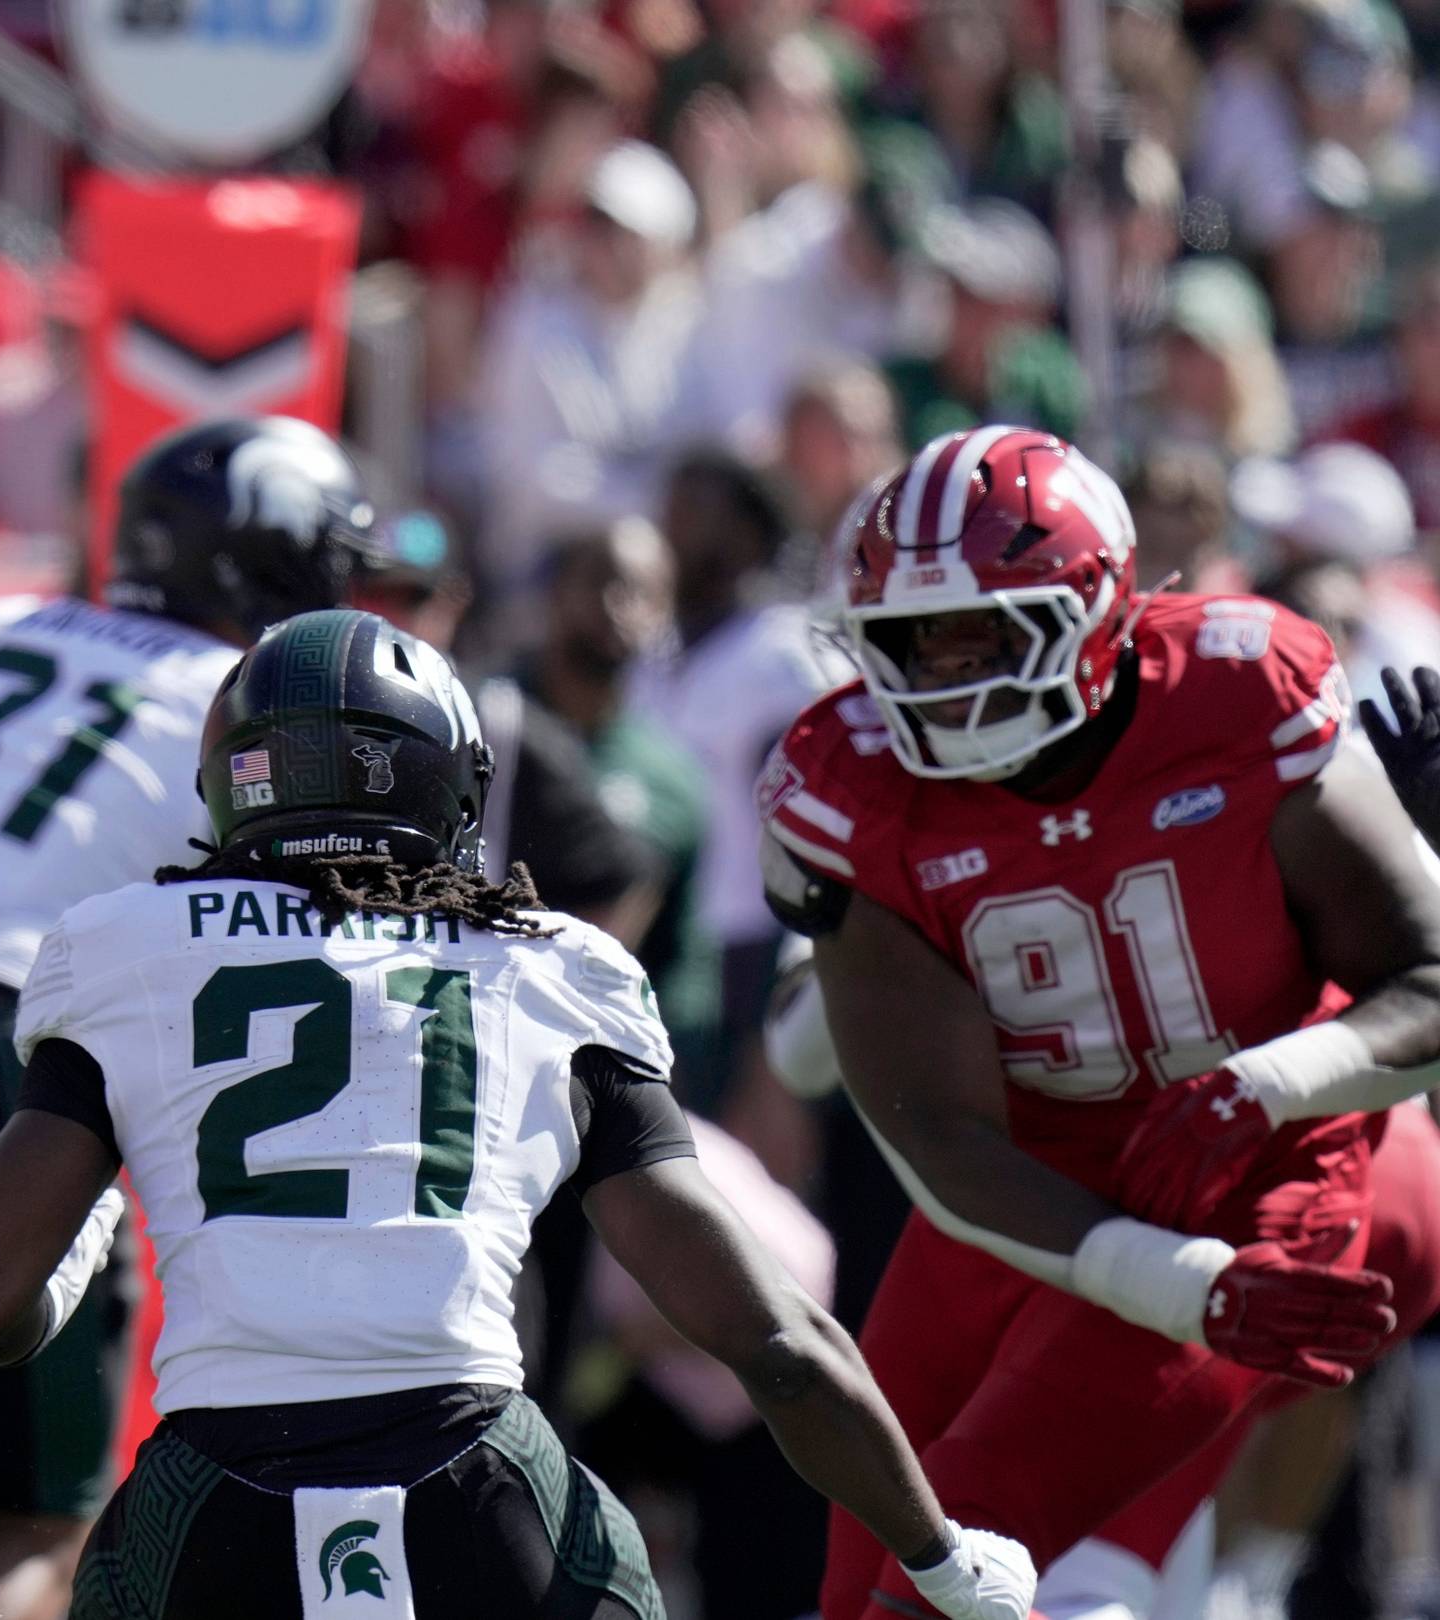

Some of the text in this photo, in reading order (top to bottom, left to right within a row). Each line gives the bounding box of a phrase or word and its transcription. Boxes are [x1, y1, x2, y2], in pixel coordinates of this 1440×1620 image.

[281, 834, 362, 857] msufcu
[193, 958, 477, 1223] 21
[961, 860, 1239, 1102] 91
